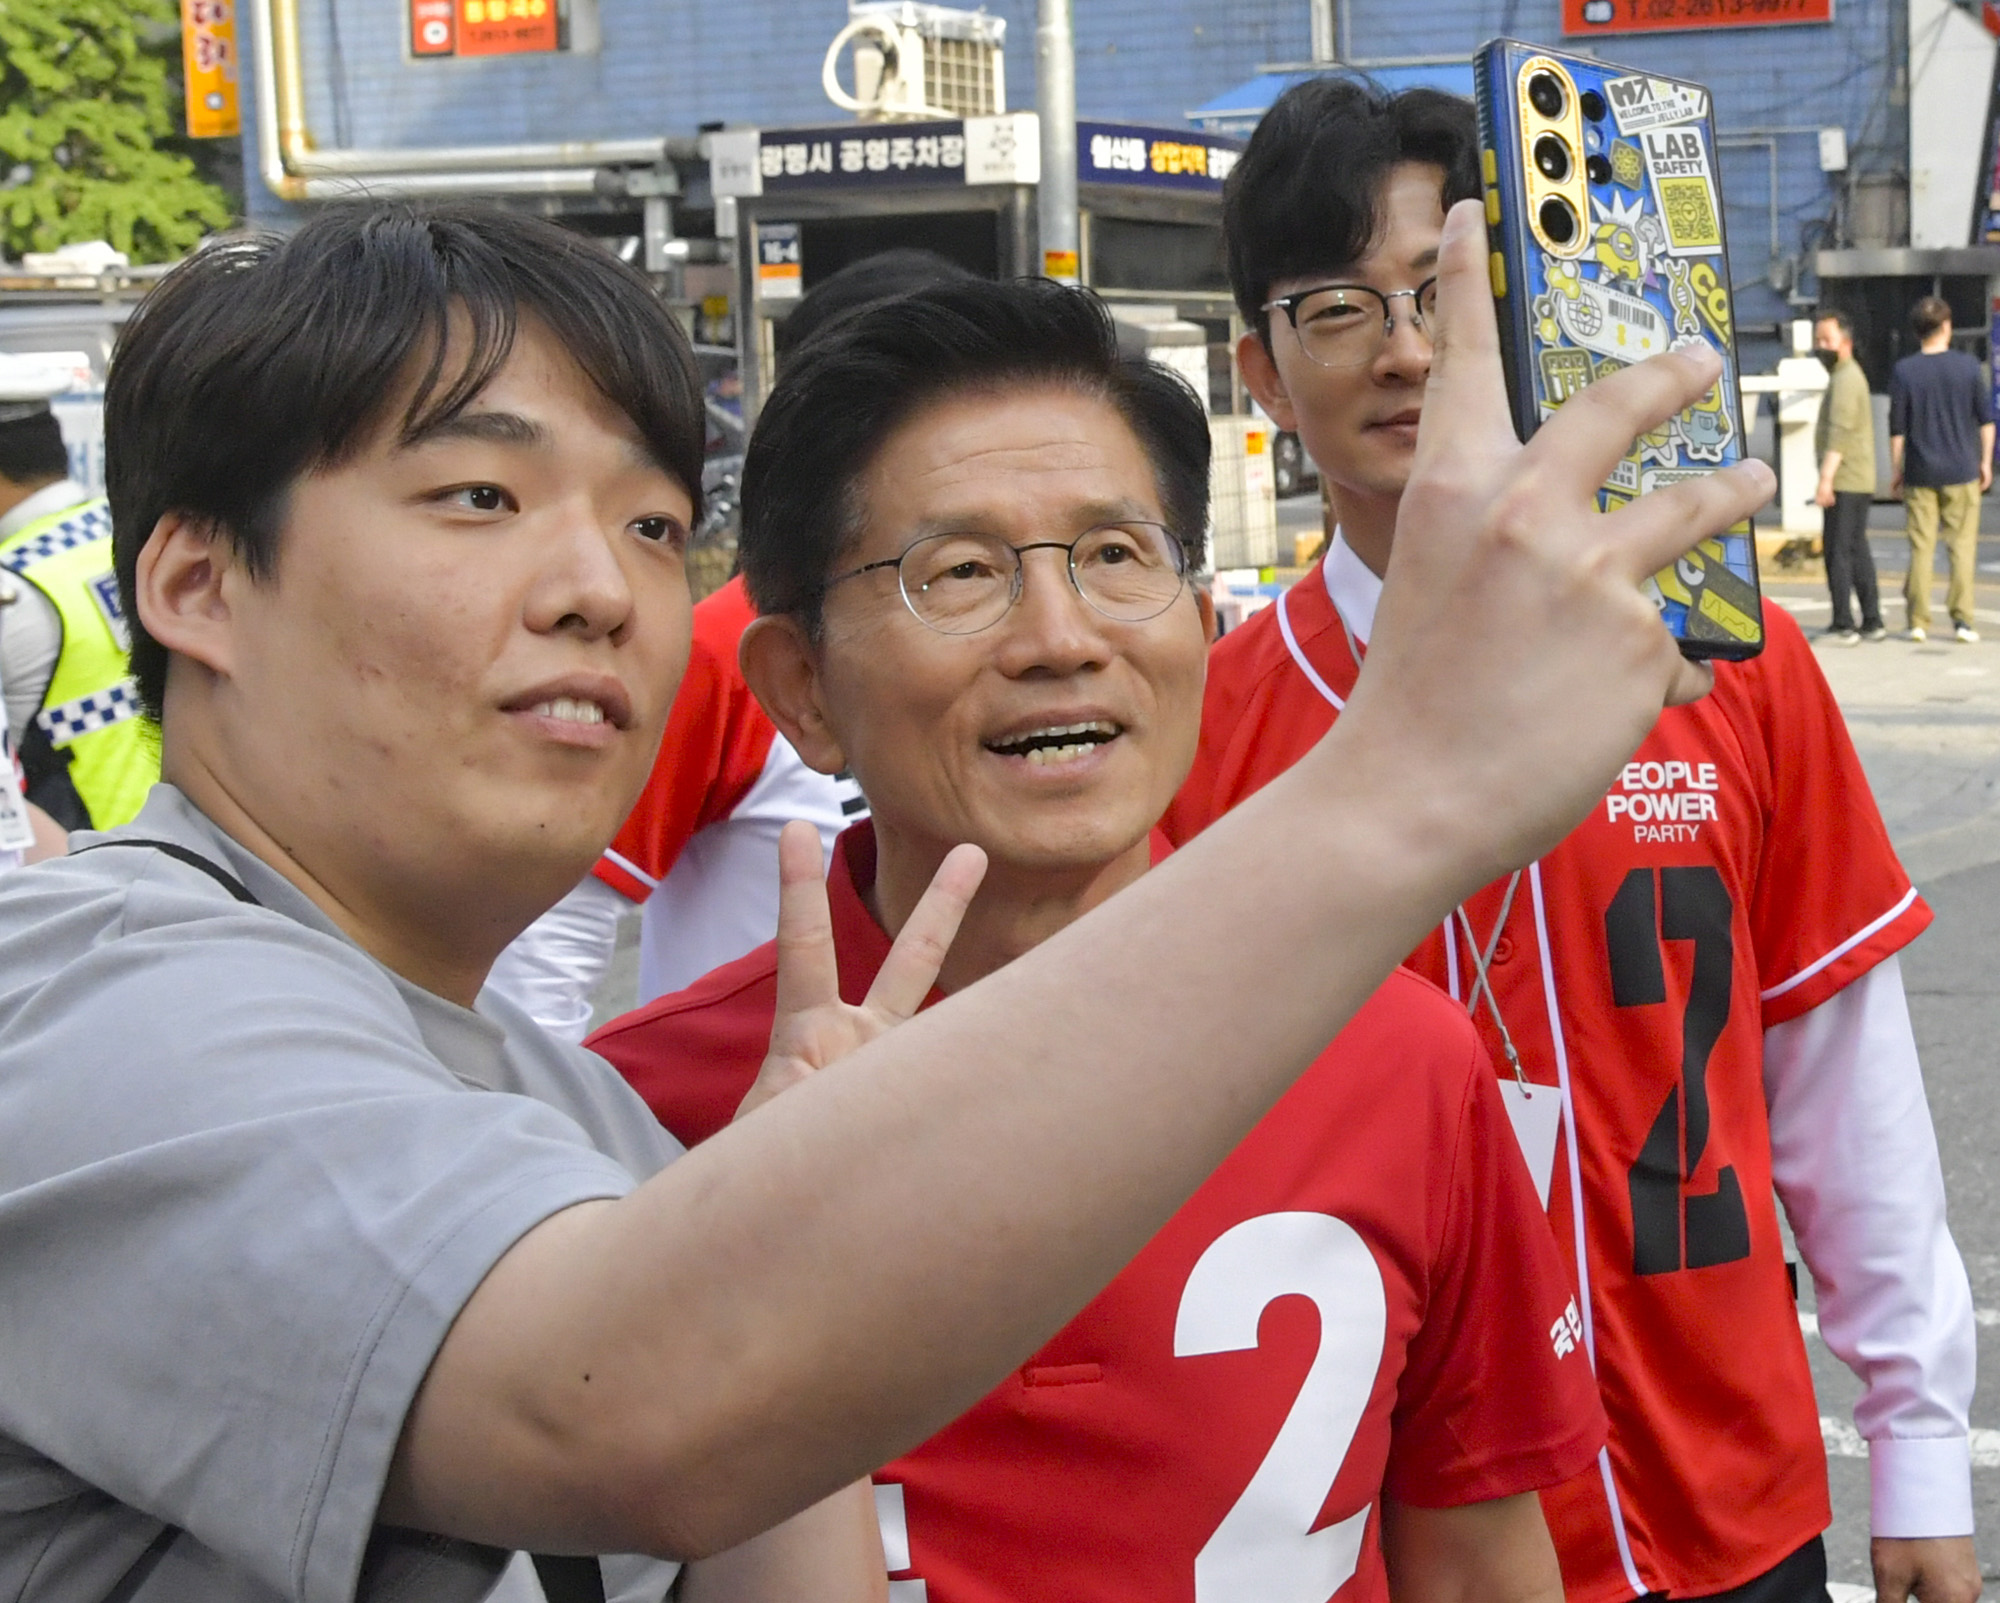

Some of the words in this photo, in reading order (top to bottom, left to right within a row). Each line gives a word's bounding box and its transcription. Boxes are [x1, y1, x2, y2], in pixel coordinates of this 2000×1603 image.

[761, 141, 833, 177] 광명시
[839, 135, 964, 173] 공영주차장
[1150, 140, 1208, 176] 상업지역
[1646, 133, 1701, 160] LAB
[1653, 160, 1703, 175] SAFETY
[1611, 761, 1719, 790] EOPLE
[1606, 793, 1718, 823] POWER
[1634, 824, 1700, 843] PARTY
[1604, 866, 1751, 1276] 2
[1174, 1211, 1387, 1603] 2
